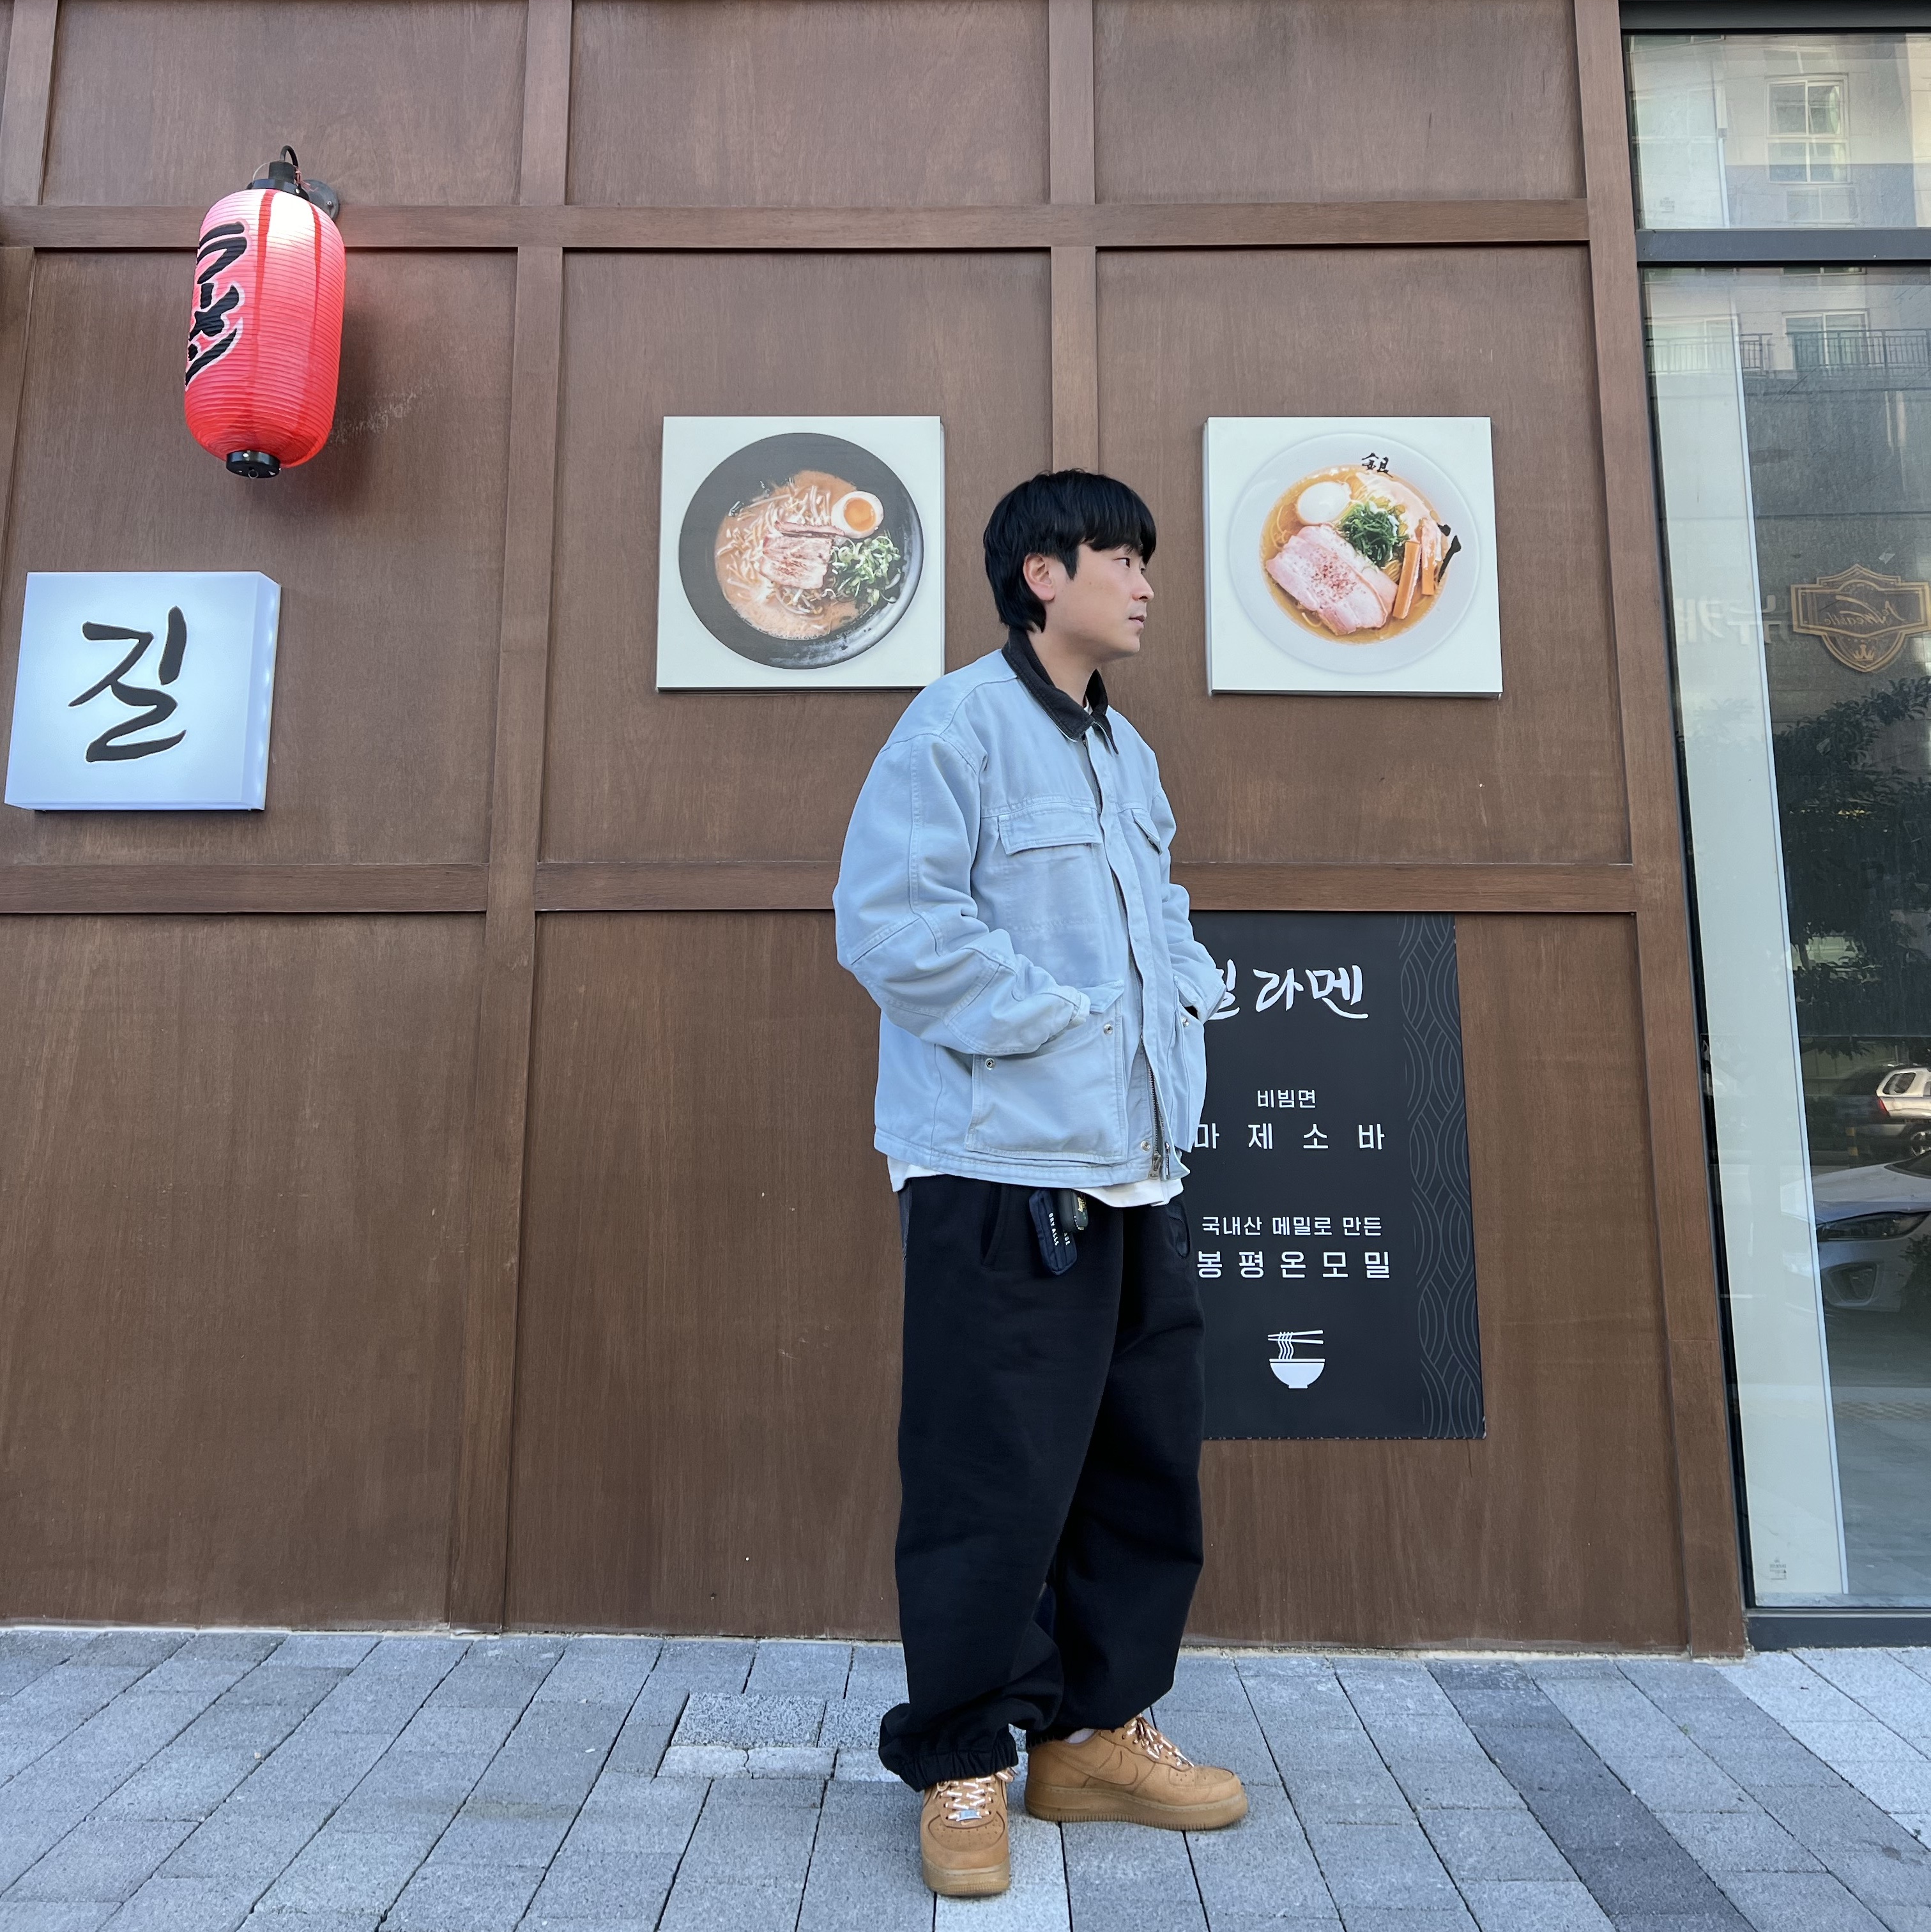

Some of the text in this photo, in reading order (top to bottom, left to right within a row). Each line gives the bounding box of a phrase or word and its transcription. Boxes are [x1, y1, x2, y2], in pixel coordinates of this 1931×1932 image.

[185, 221, 247, 387] ラーメン
[1257, 1090, 1316, 1109] 비빔면
[1202, 1216, 1382, 1236] 국내산 메밀로 만든
